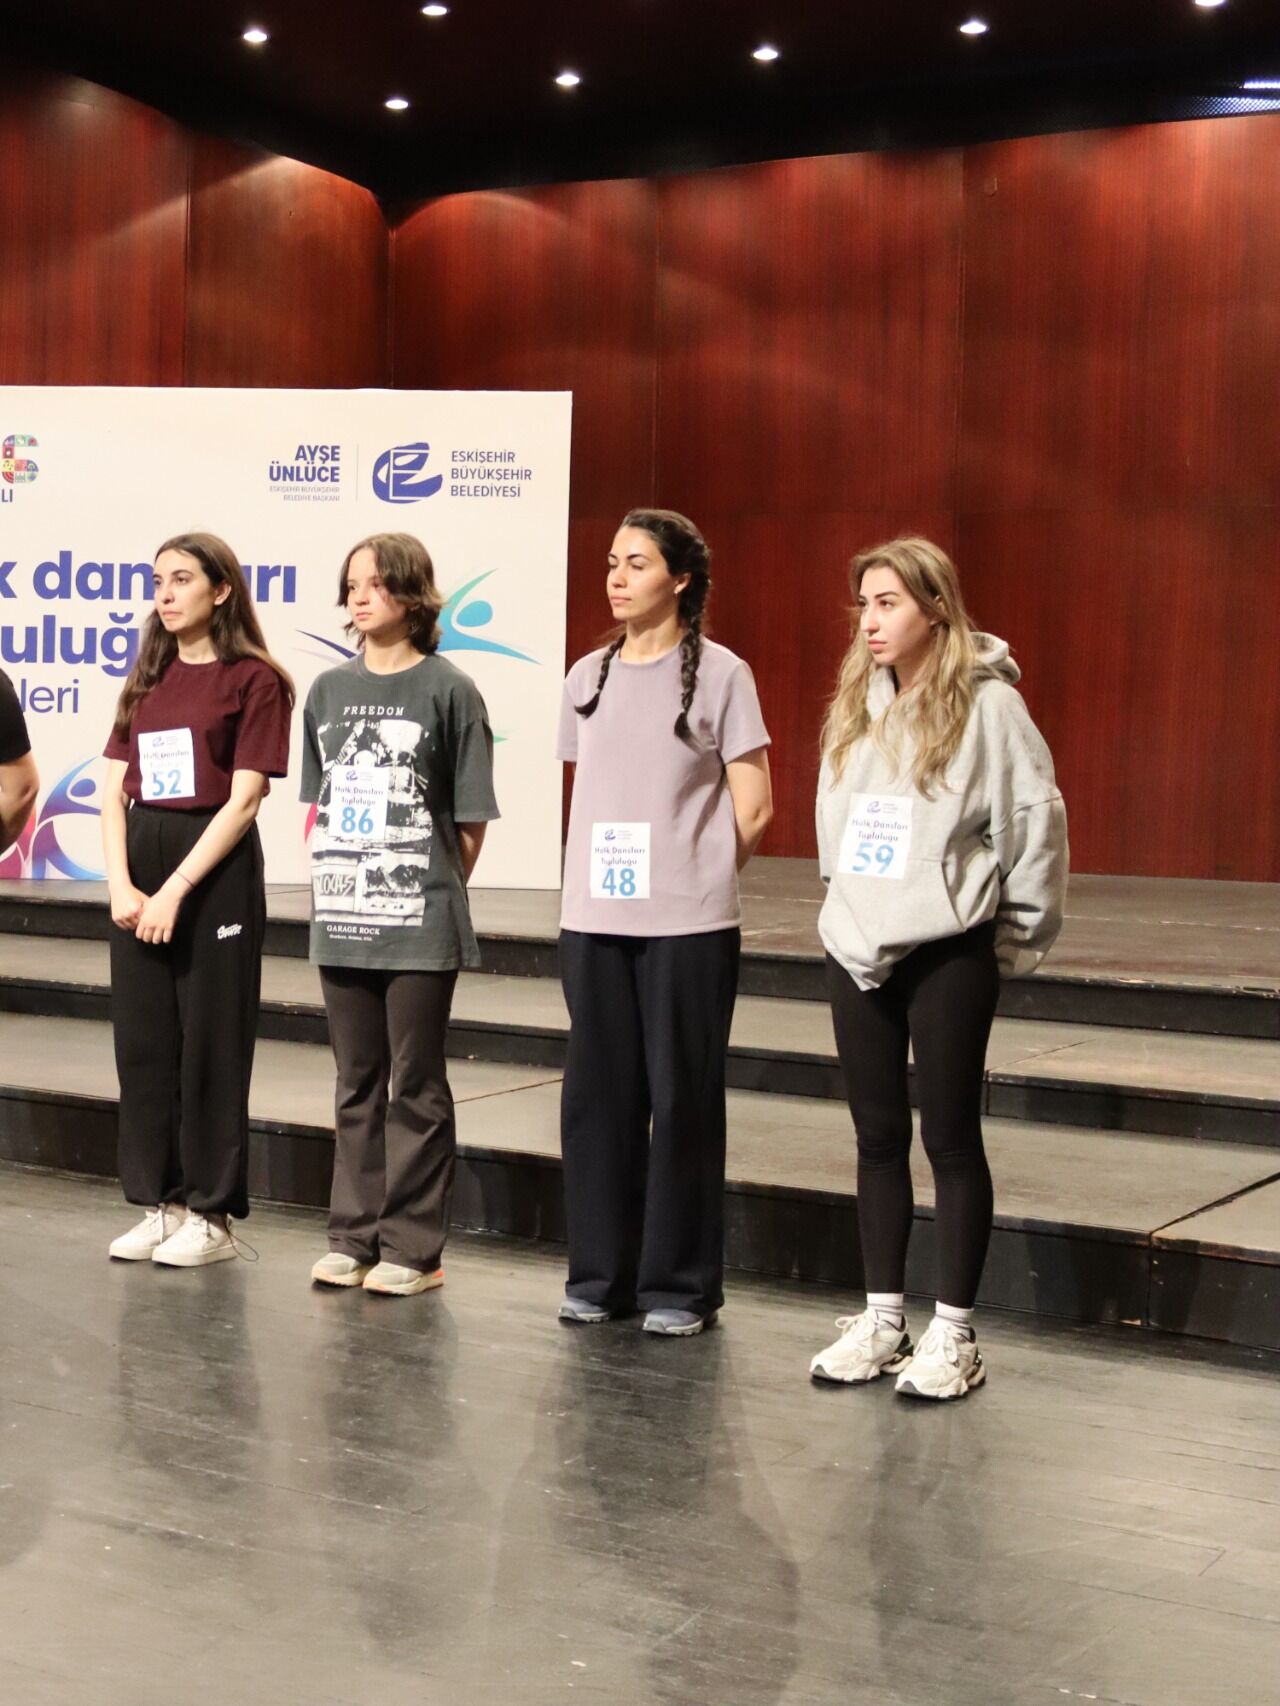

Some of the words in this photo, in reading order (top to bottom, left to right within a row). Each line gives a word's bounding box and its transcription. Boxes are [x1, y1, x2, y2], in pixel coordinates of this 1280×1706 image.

[294, 444, 341, 464] AYŞE
[451, 448, 516, 463] ESKİŞEHİR
[269, 460, 340, 482] ÜNLÜCE
[451, 465, 532, 481] BÜYÜKŞEHİR
[450, 483, 521, 497] BELEDİYESİ
[343, 705, 405, 716] FREEDOM
[152, 769, 182, 797] 52
[341, 806, 374, 834] 86
[852, 842, 894, 874] 59
[602, 868, 636, 897] 48
[326, 924, 358, 934] GARAGE
[359, 927, 381, 935] ROCK
